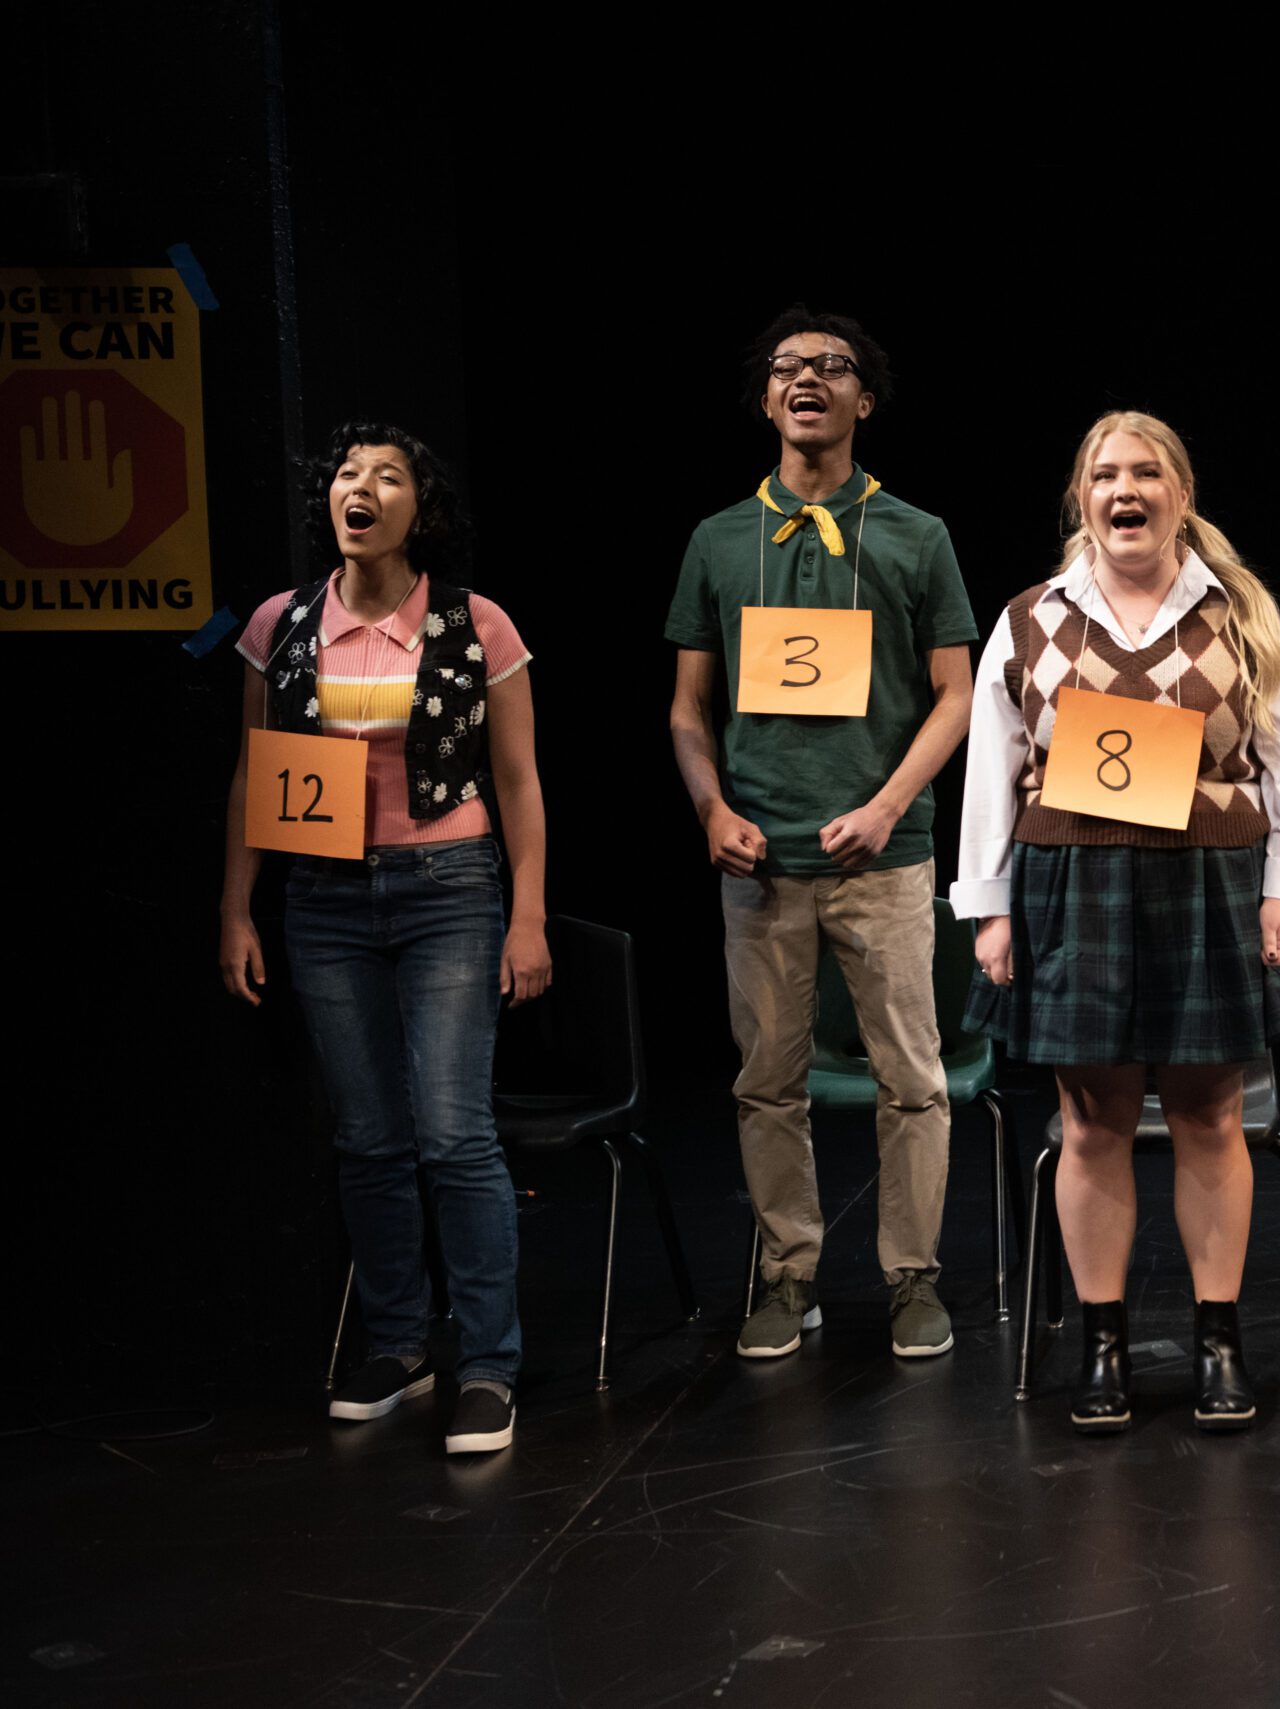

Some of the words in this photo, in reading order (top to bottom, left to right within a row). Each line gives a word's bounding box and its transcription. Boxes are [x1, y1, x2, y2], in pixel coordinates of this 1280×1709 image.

[0, 286, 175, 313] GETHER
[0, 322, 41, 360] E
[59, 321, 175, 360] CAN
[780, 635, 821, 687] 3
[1096, 729, 1132, 791] 8
[278, 768, 333, 823] 12
